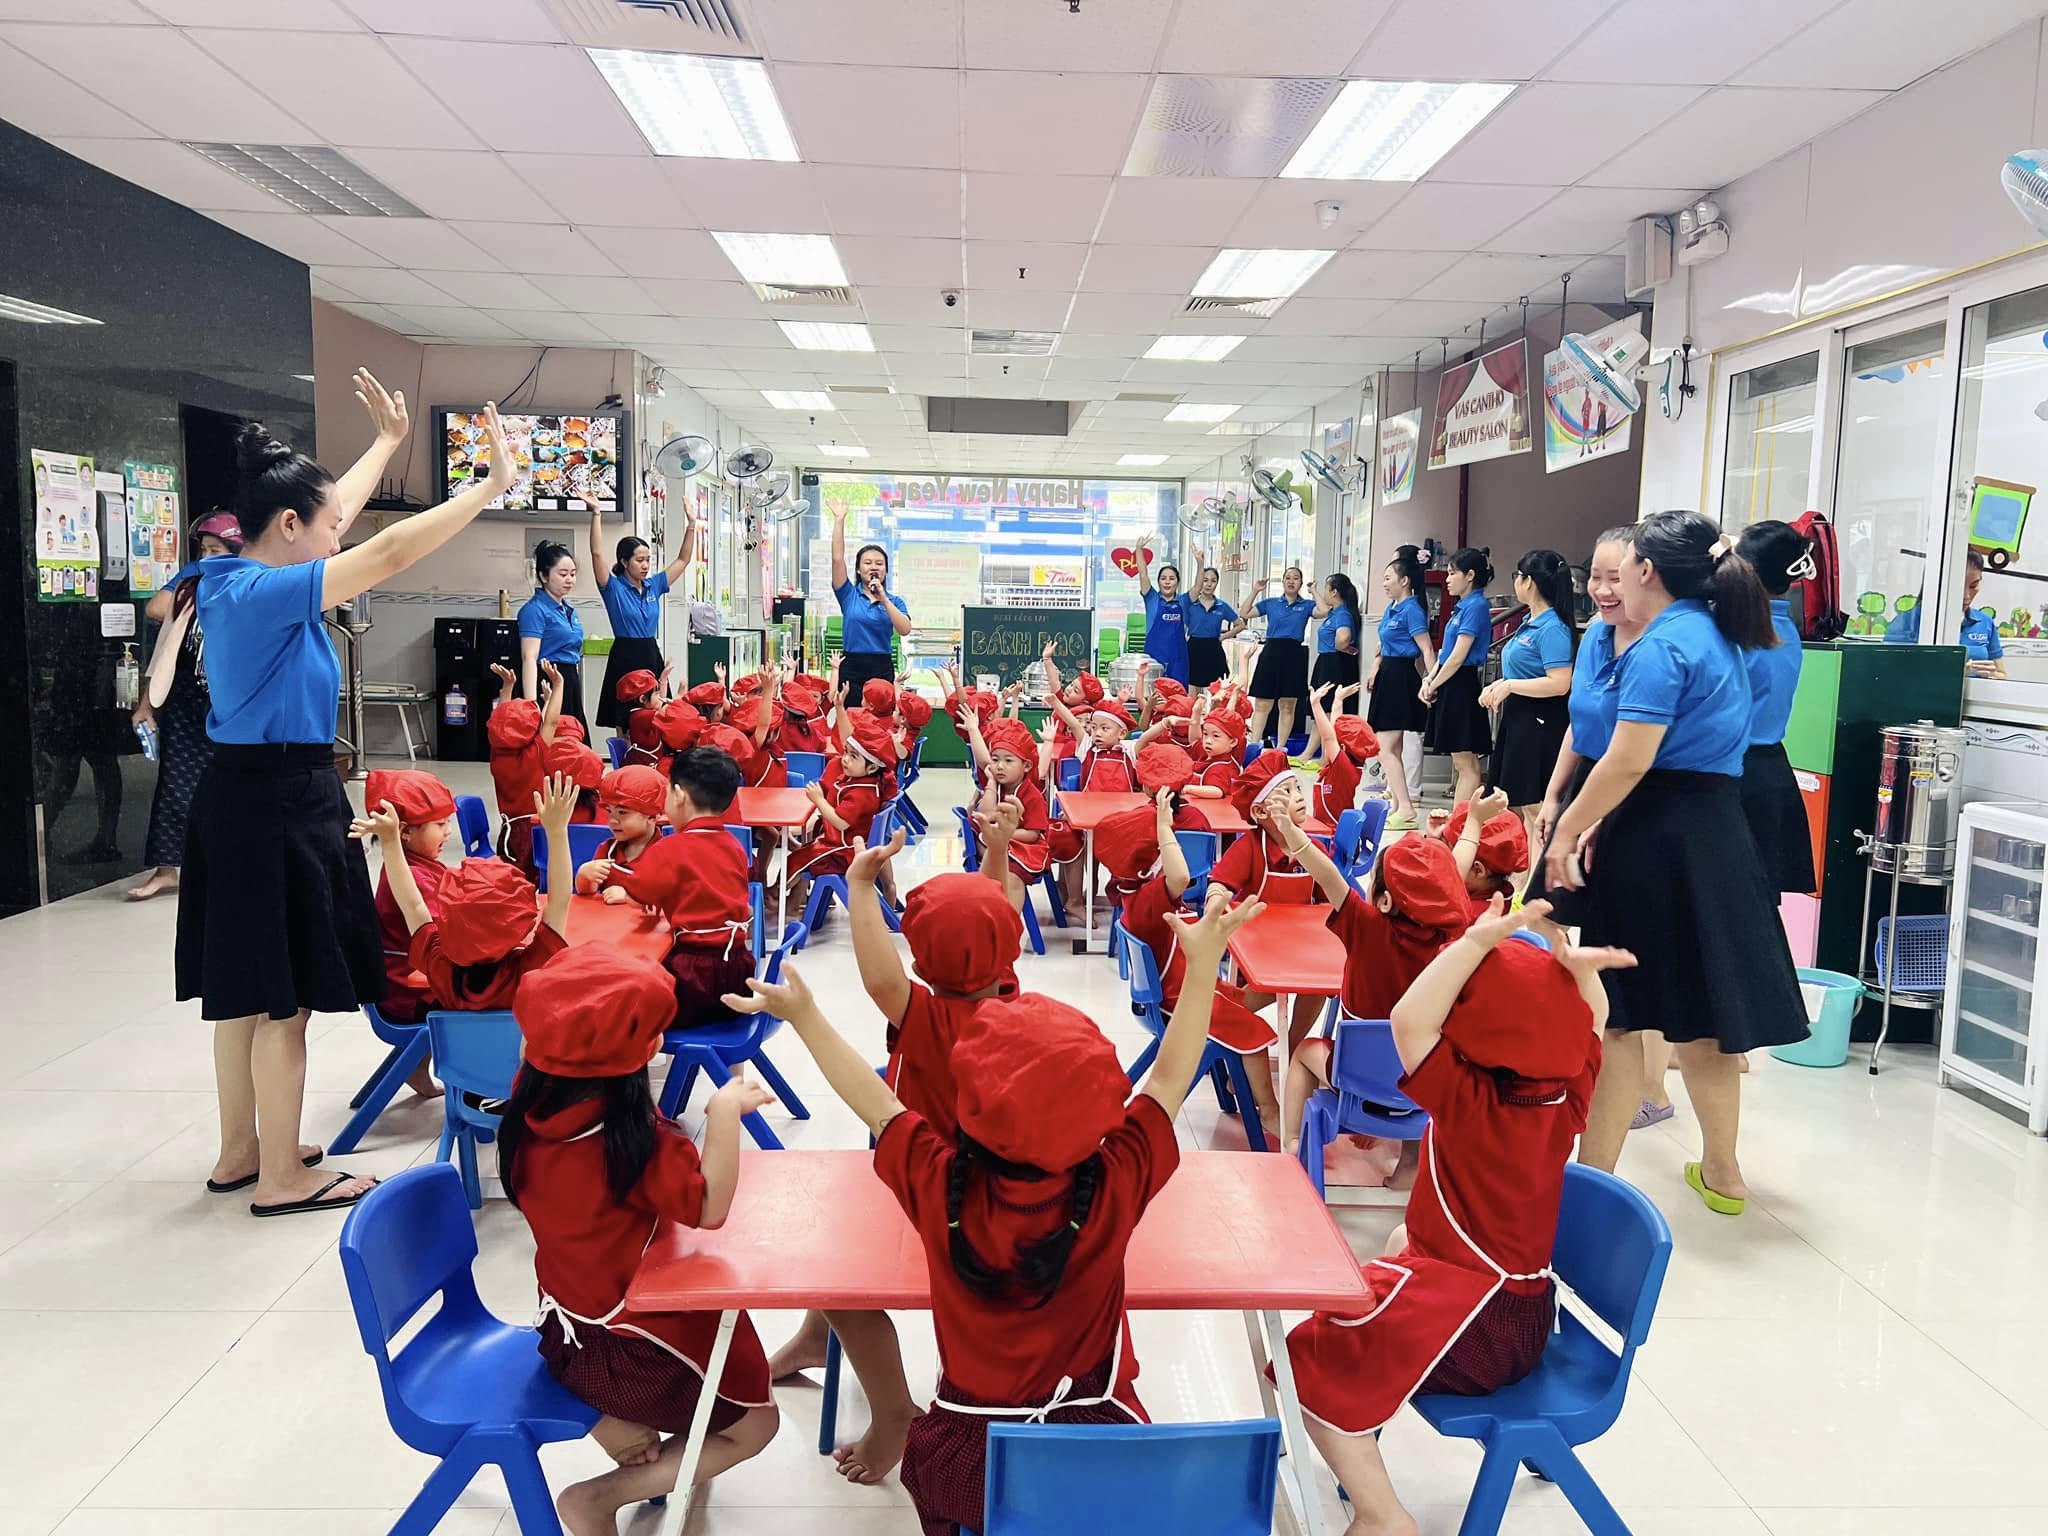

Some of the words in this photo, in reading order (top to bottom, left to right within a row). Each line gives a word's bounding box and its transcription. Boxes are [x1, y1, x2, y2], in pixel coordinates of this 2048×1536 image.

[1448, 425, 1479, 449] BEAUTY
[1479, 418, 1509, 443] SALON
[971, 624, 1031, 656] BÁNH
